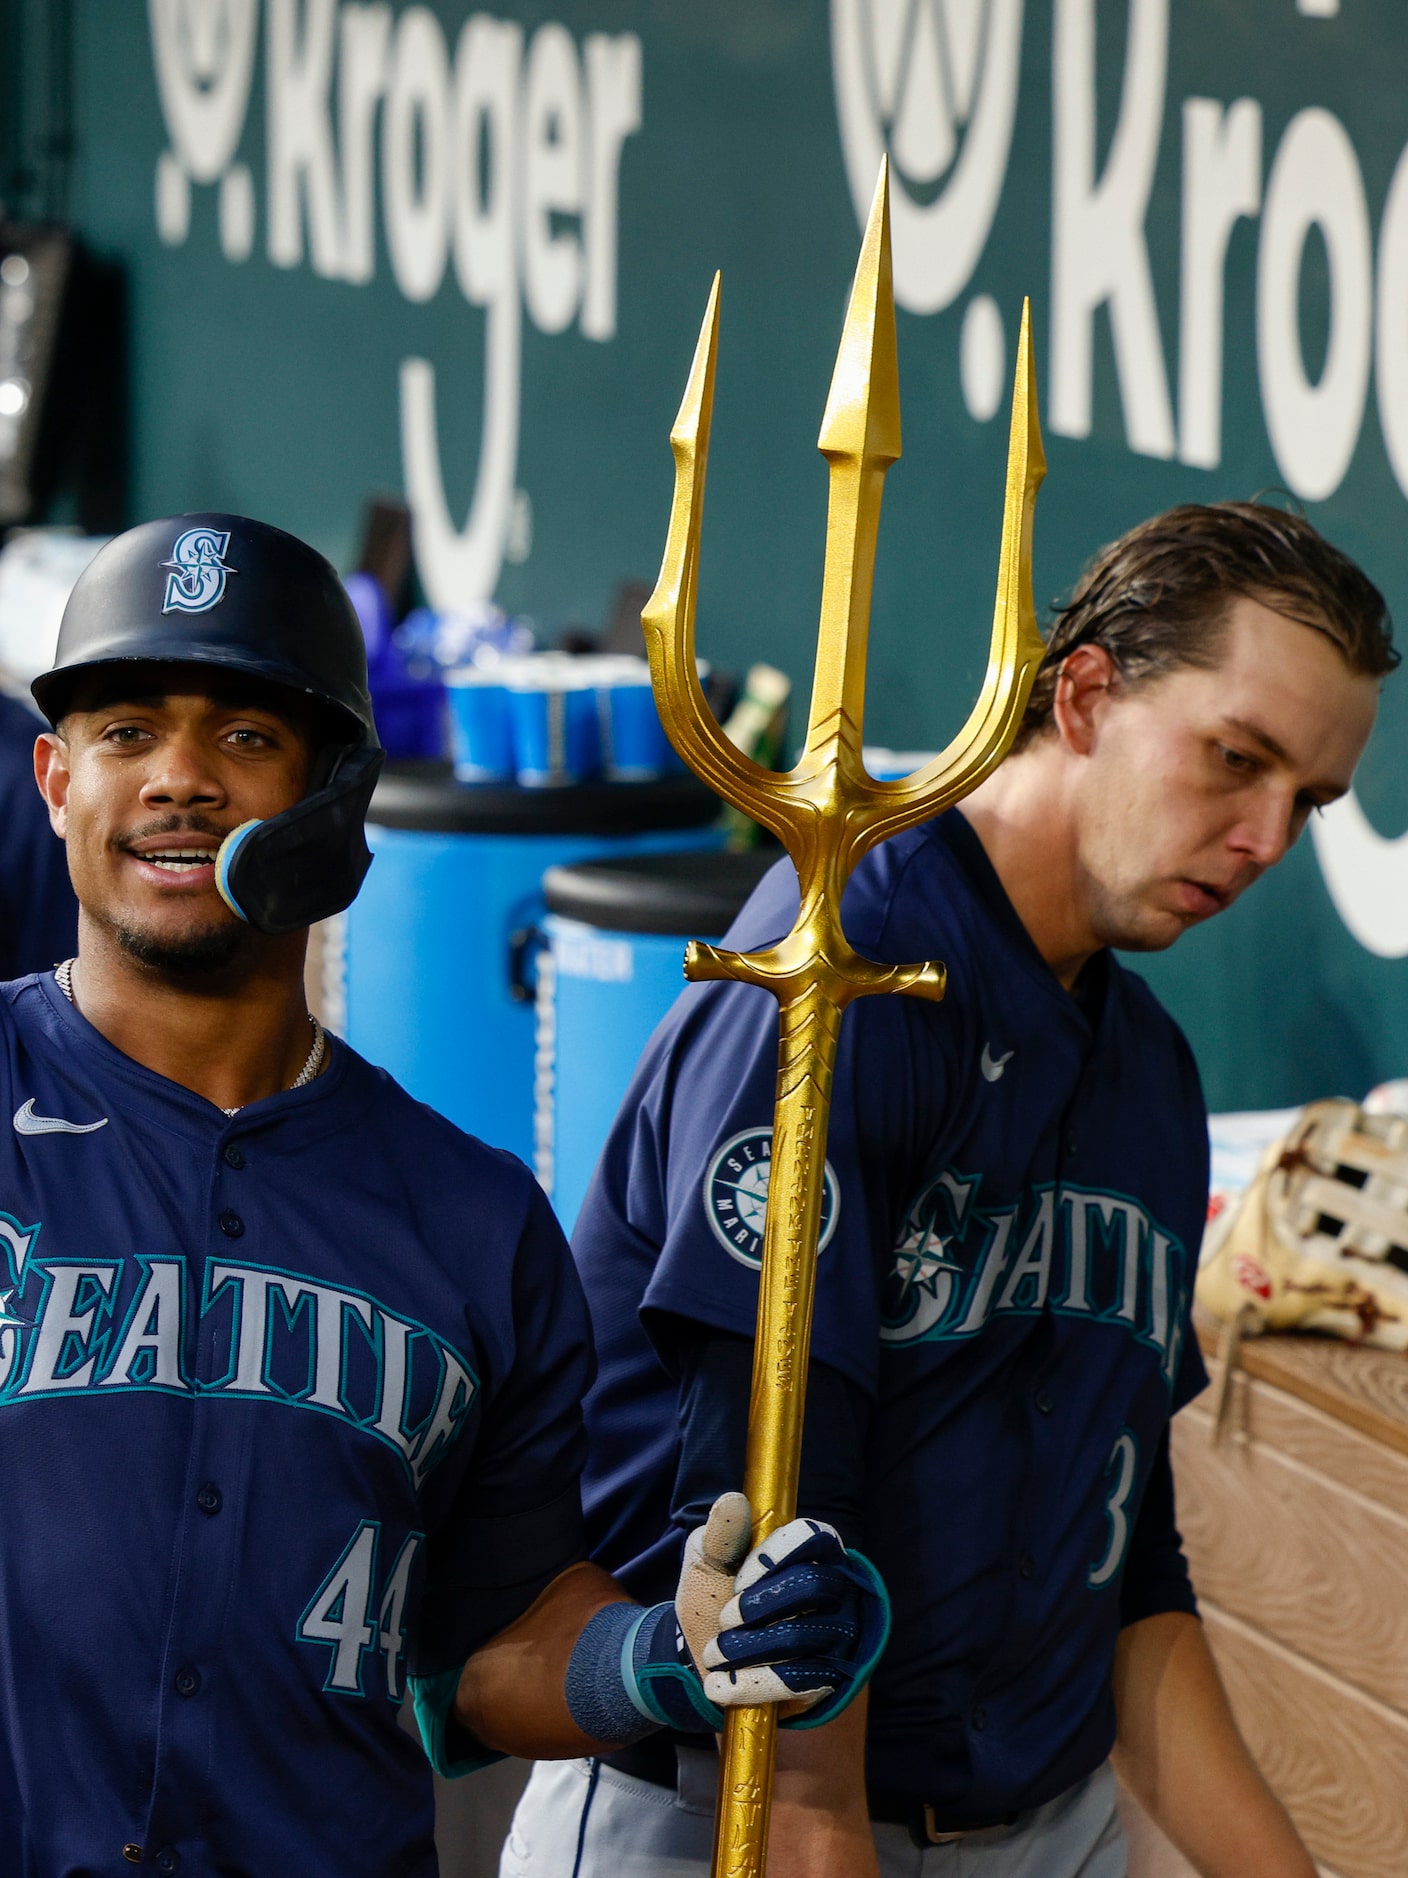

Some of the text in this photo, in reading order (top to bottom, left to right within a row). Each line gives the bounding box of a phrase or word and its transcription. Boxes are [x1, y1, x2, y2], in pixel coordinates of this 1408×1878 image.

[160, 527, 234, 613] S
[716, 1198, 759, 1253] MARI
[1087, 1425, 1138, 1592] 3
[296, 1519, 426, 1704] 44
